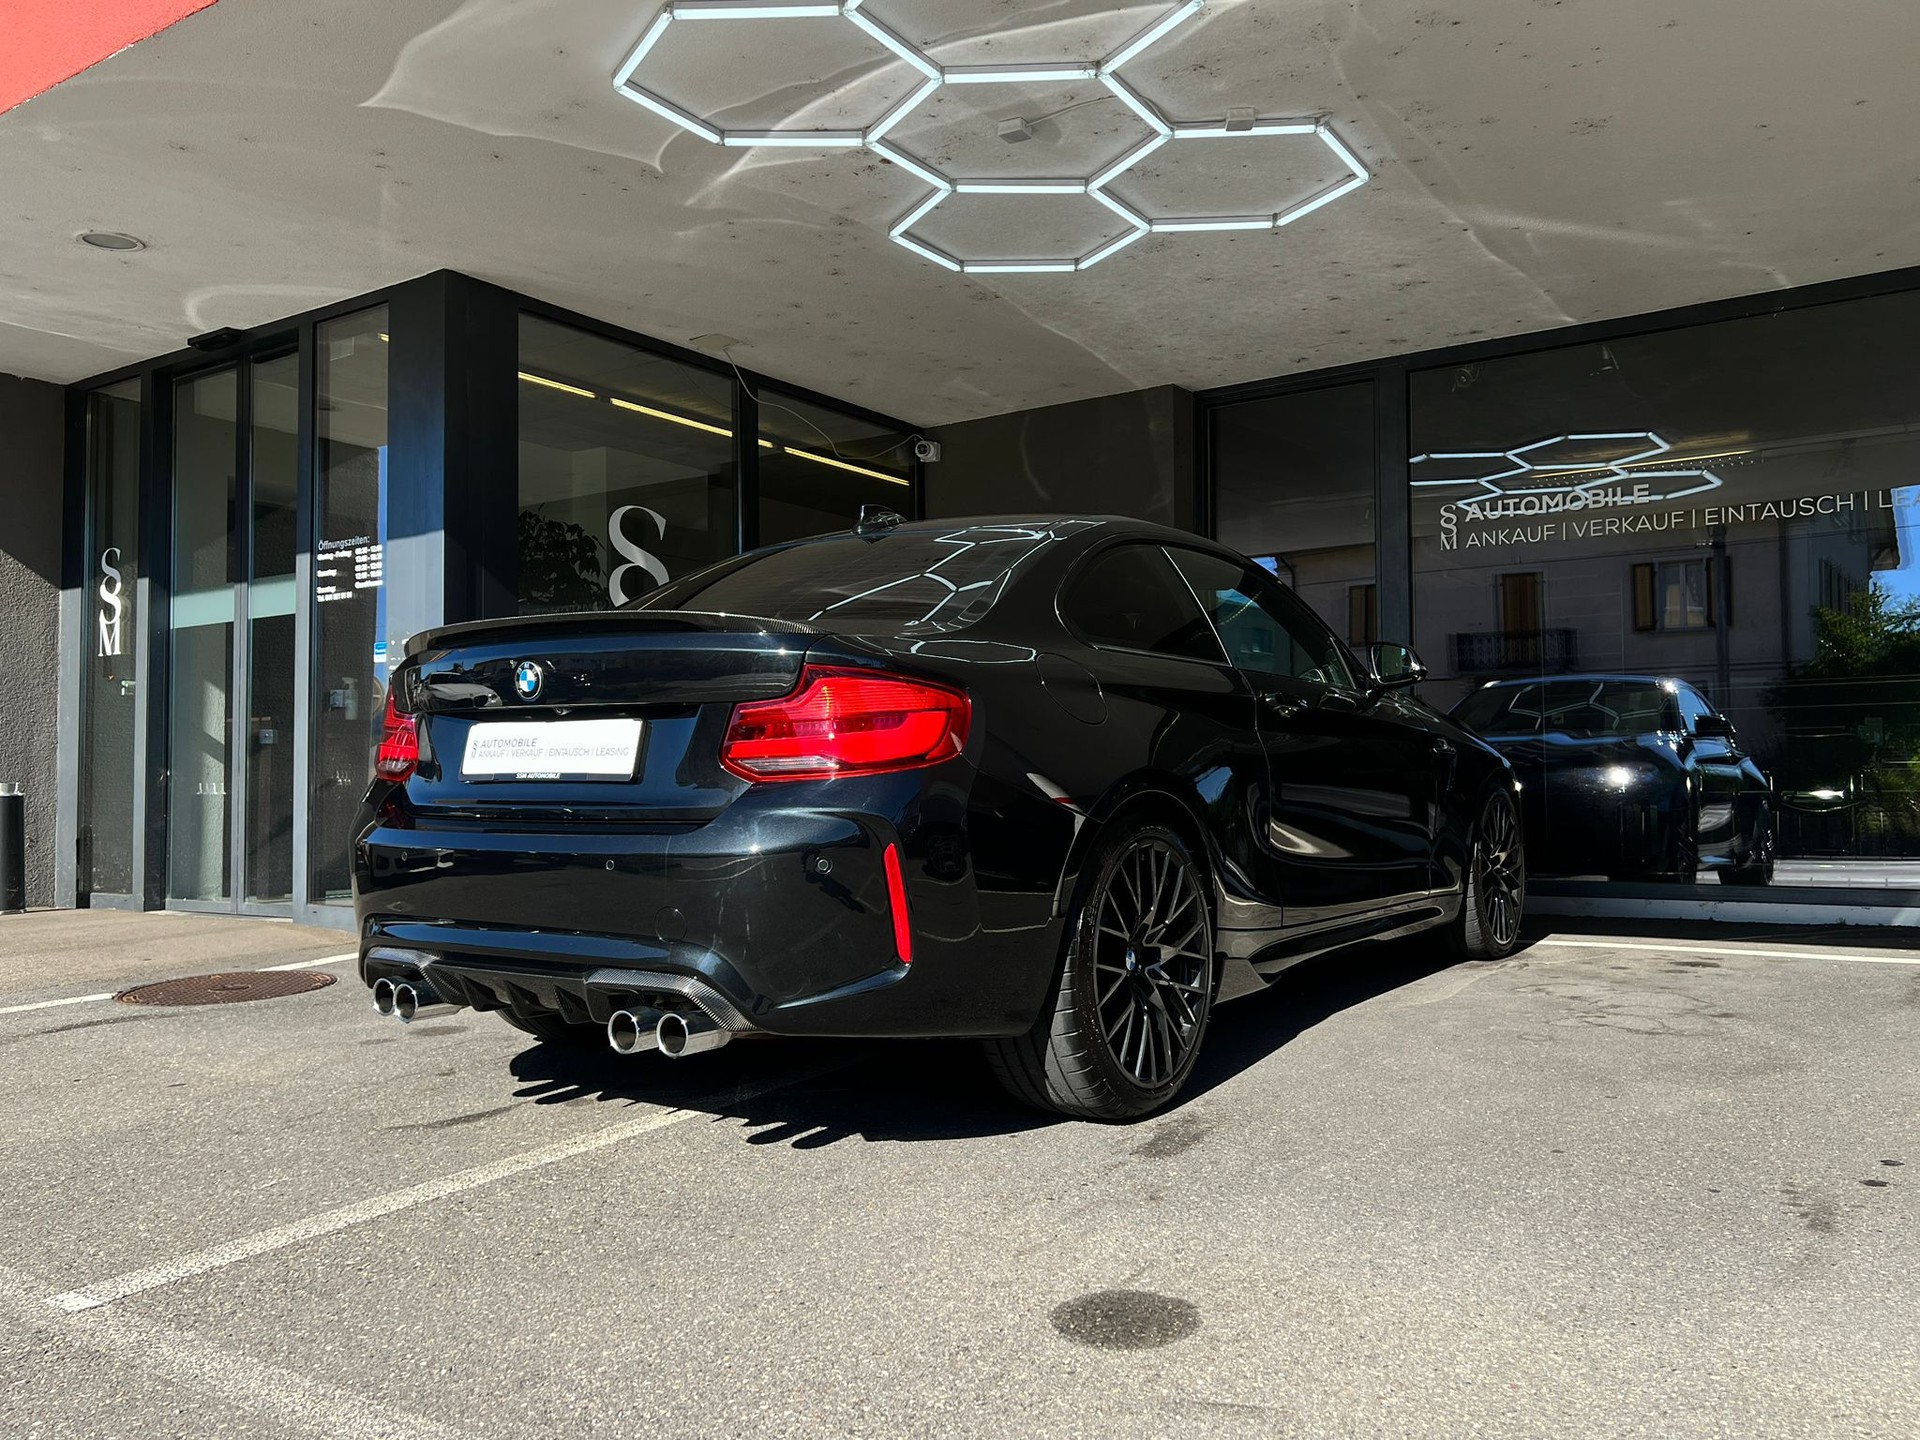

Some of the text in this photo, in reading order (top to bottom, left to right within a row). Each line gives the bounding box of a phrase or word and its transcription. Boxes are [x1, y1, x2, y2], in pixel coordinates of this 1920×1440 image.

[1465, 483, 1650, 522] AUTOMOBILE
[1465, 524, 1556, 549] ANKAUF
[1572, 511, 1685, 538] VERKAUF
[1705, 492, 1854, 526] EINTAUSCH
[480, 737, 538, 749] AUTOMOBILE
[511, 747, 544, 757] VERKAUF
[548, 746, 590, 757] EINTAUSCH
[595, 746, 630, 757] LEASING
